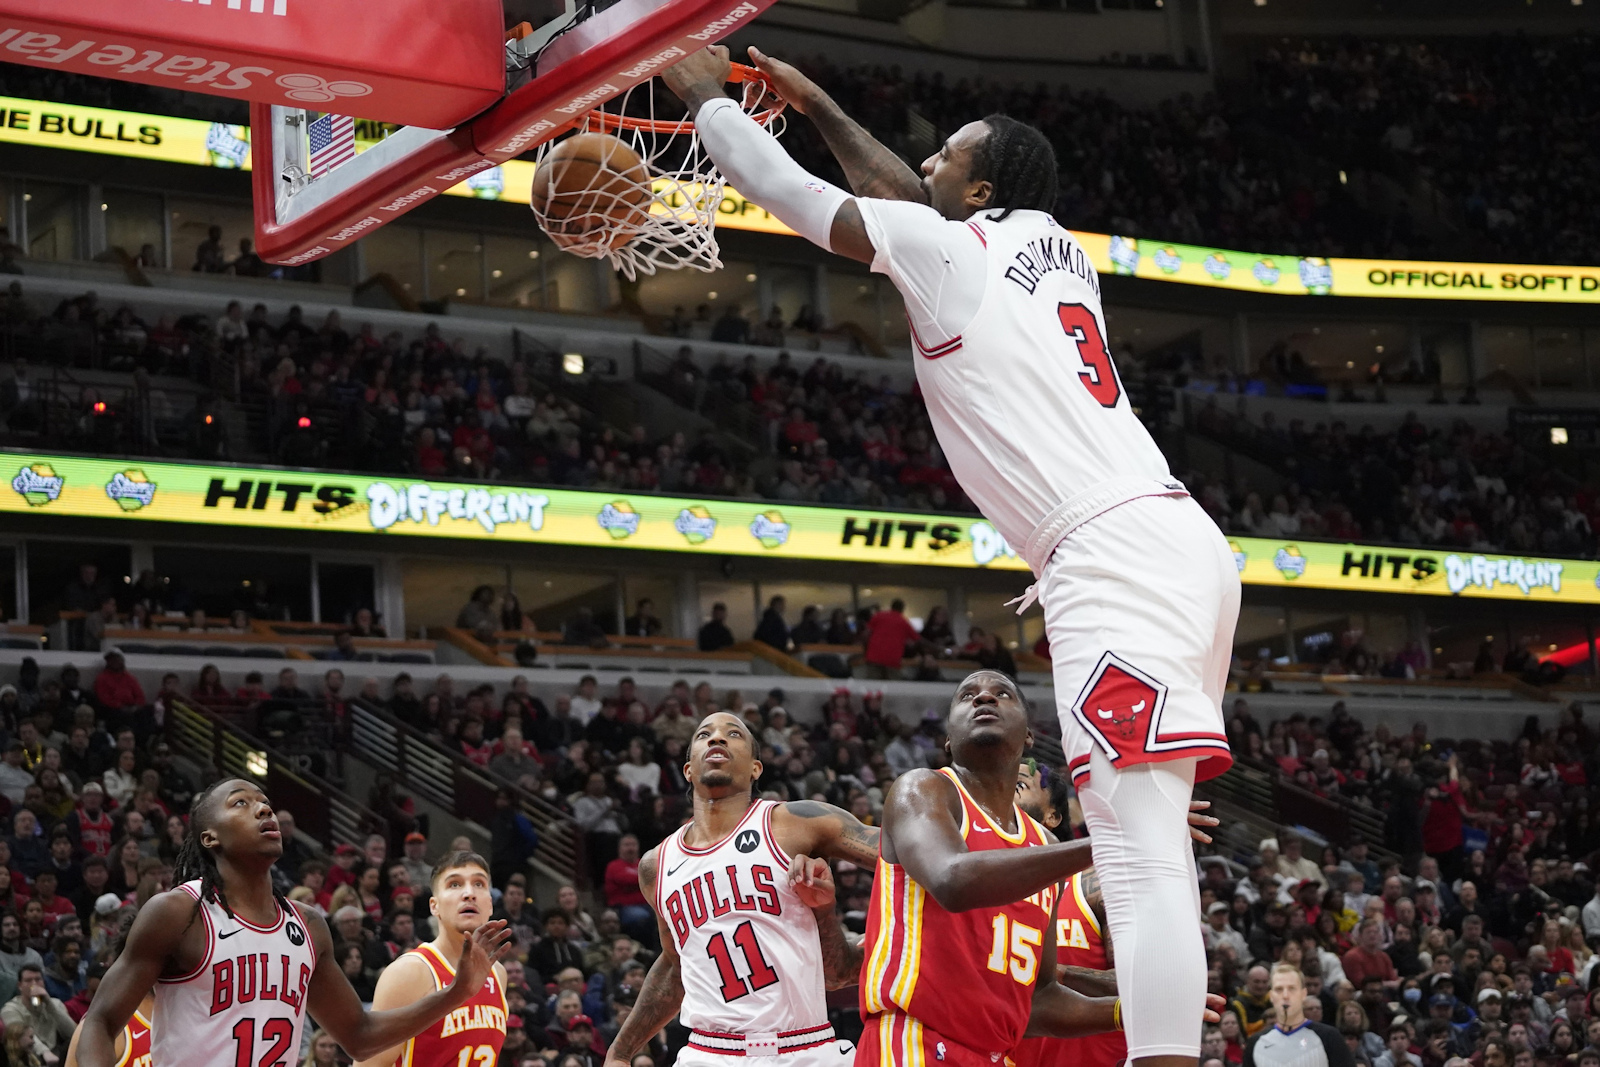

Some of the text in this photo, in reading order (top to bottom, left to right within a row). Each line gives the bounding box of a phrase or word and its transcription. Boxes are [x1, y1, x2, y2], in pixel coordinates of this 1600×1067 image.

[687, 1, 758, 41] betway
[620, 44, 687, 79] betway
[555, 82, 620, 115] betway
[39, 112, 163, 146] BULLS
[496, 118, 556, 154] betway
[436, 158, 496, 181] betway
[379, 185, 438, 212] betway
[327, 214, 383, 241] betway
[1004, 236, 1101, 297] DRUMMON
[1368, 269, 1494, 289] OFFICIAL
[1501, 273, 1573, 291] SOFT
[1057, 301, 1121, 409] 3
[204, 478, 356, 513] HITS
[841, 516, 962, 550] HITS
[1341, 551, 1438, 581] HITS
[665, 864, 782, 950] BULLS
[705, 919, 780, 1004] 11
[986, 911, 1042, 986] 15
[209, 953, 311, 1017] BULLS
[440, 1004, 508, 1039] ATLANT
[232, 1017, 294, 1067] 12
